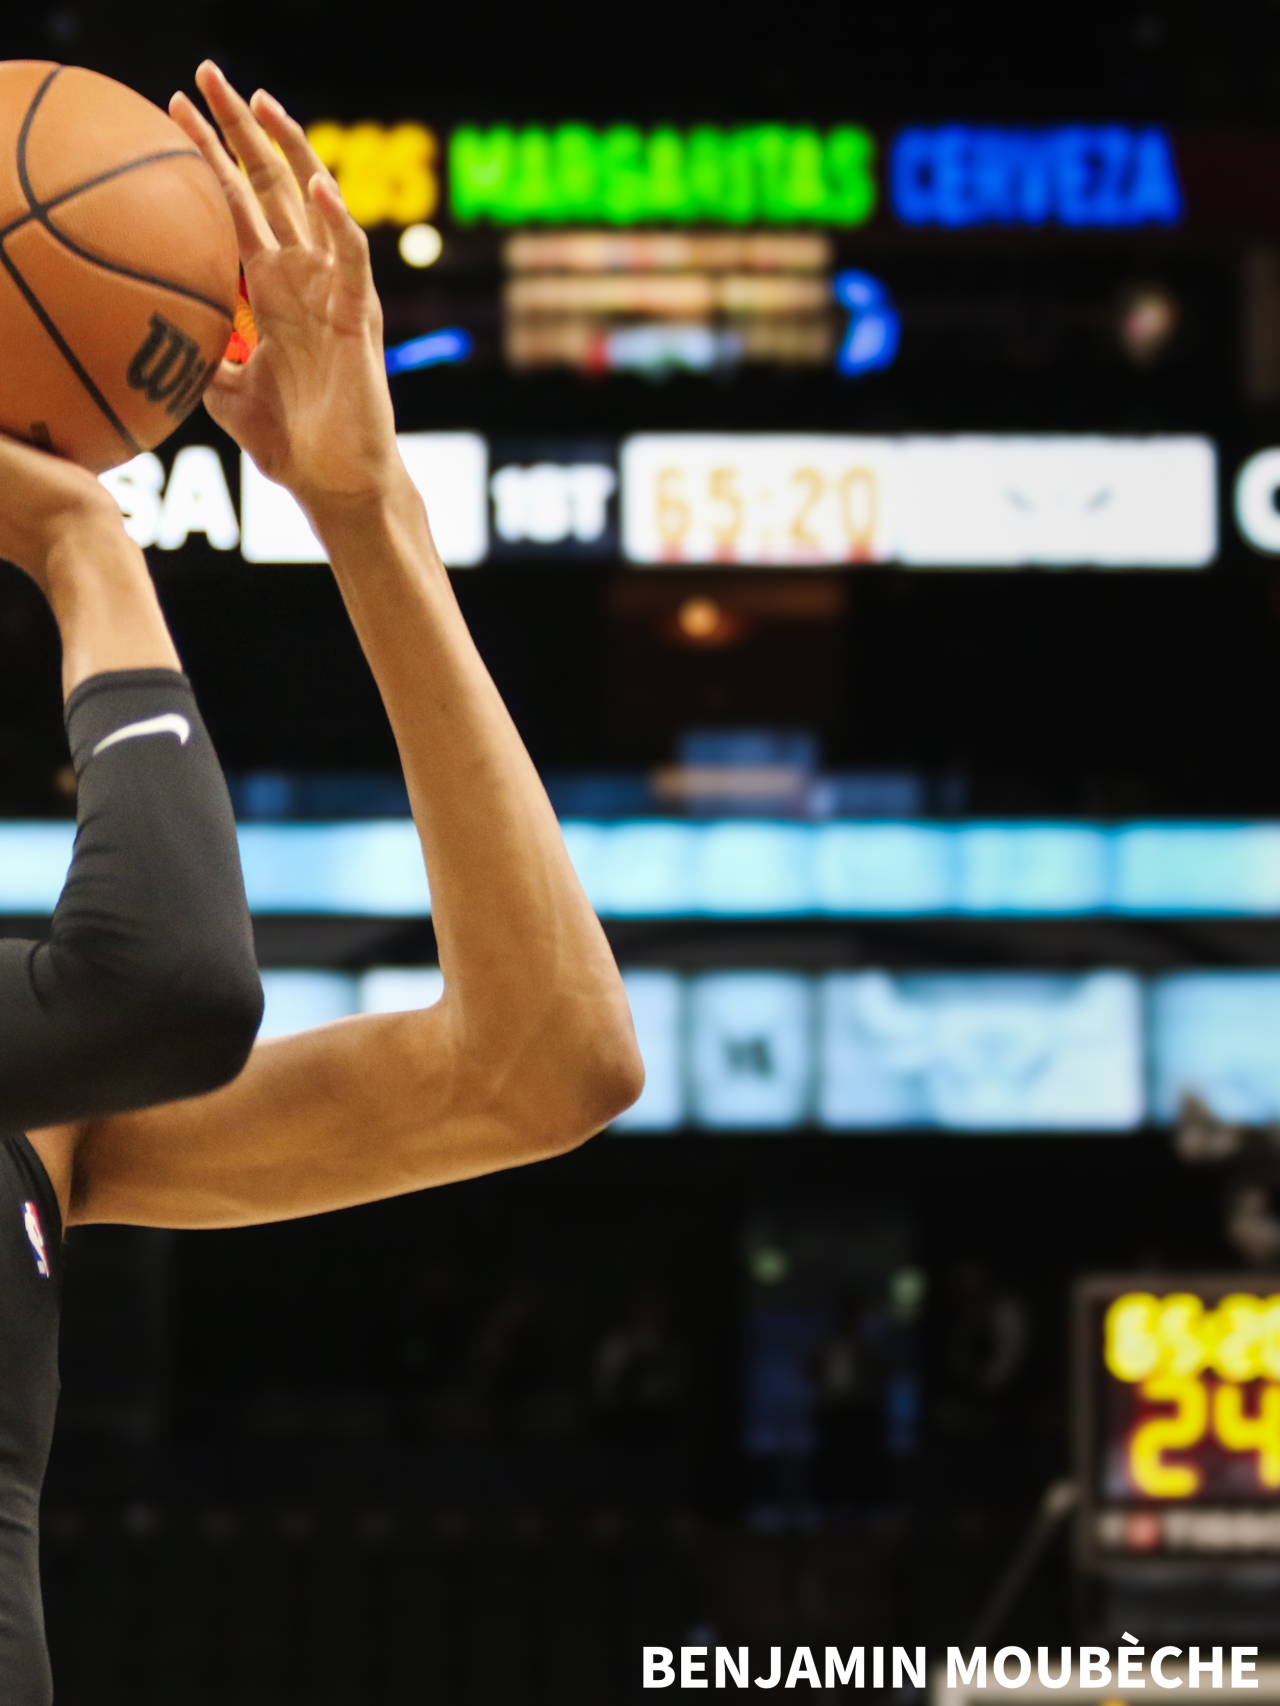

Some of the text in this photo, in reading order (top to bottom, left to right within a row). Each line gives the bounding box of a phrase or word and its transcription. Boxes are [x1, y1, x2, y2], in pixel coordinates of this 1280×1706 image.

[448, 122, 876, 226] MARGARITAS
[890, 123, 1183, 228] CERVEZA
[655, 464, 880, 556] 65:20
[1128, 1374, 1280, 1498] 24
